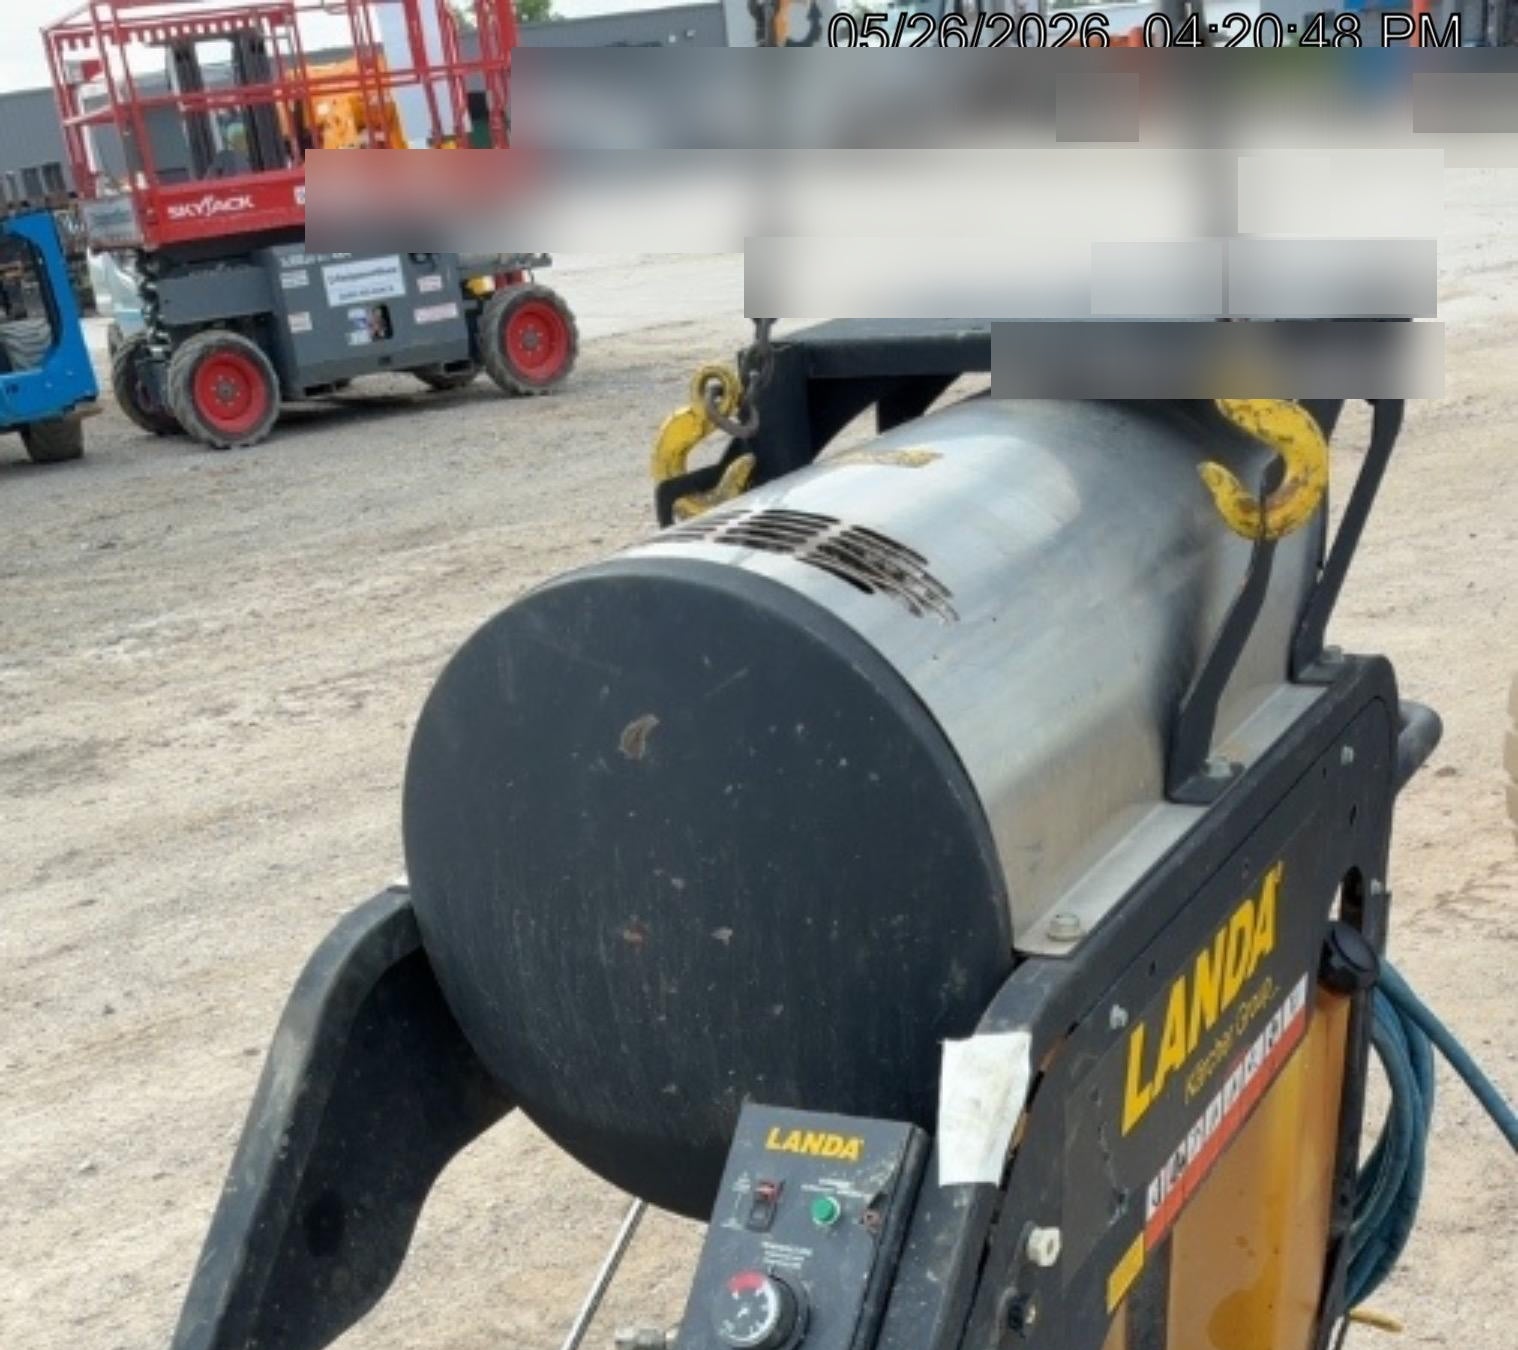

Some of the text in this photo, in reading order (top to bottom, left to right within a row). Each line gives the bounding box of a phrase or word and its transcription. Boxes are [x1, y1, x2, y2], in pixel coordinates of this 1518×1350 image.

[167, 195, 255, 219] SKYJACK
[1121, 869, 1277, 1137] LANDA
[765, 1127, 864, 1162] LANDA
